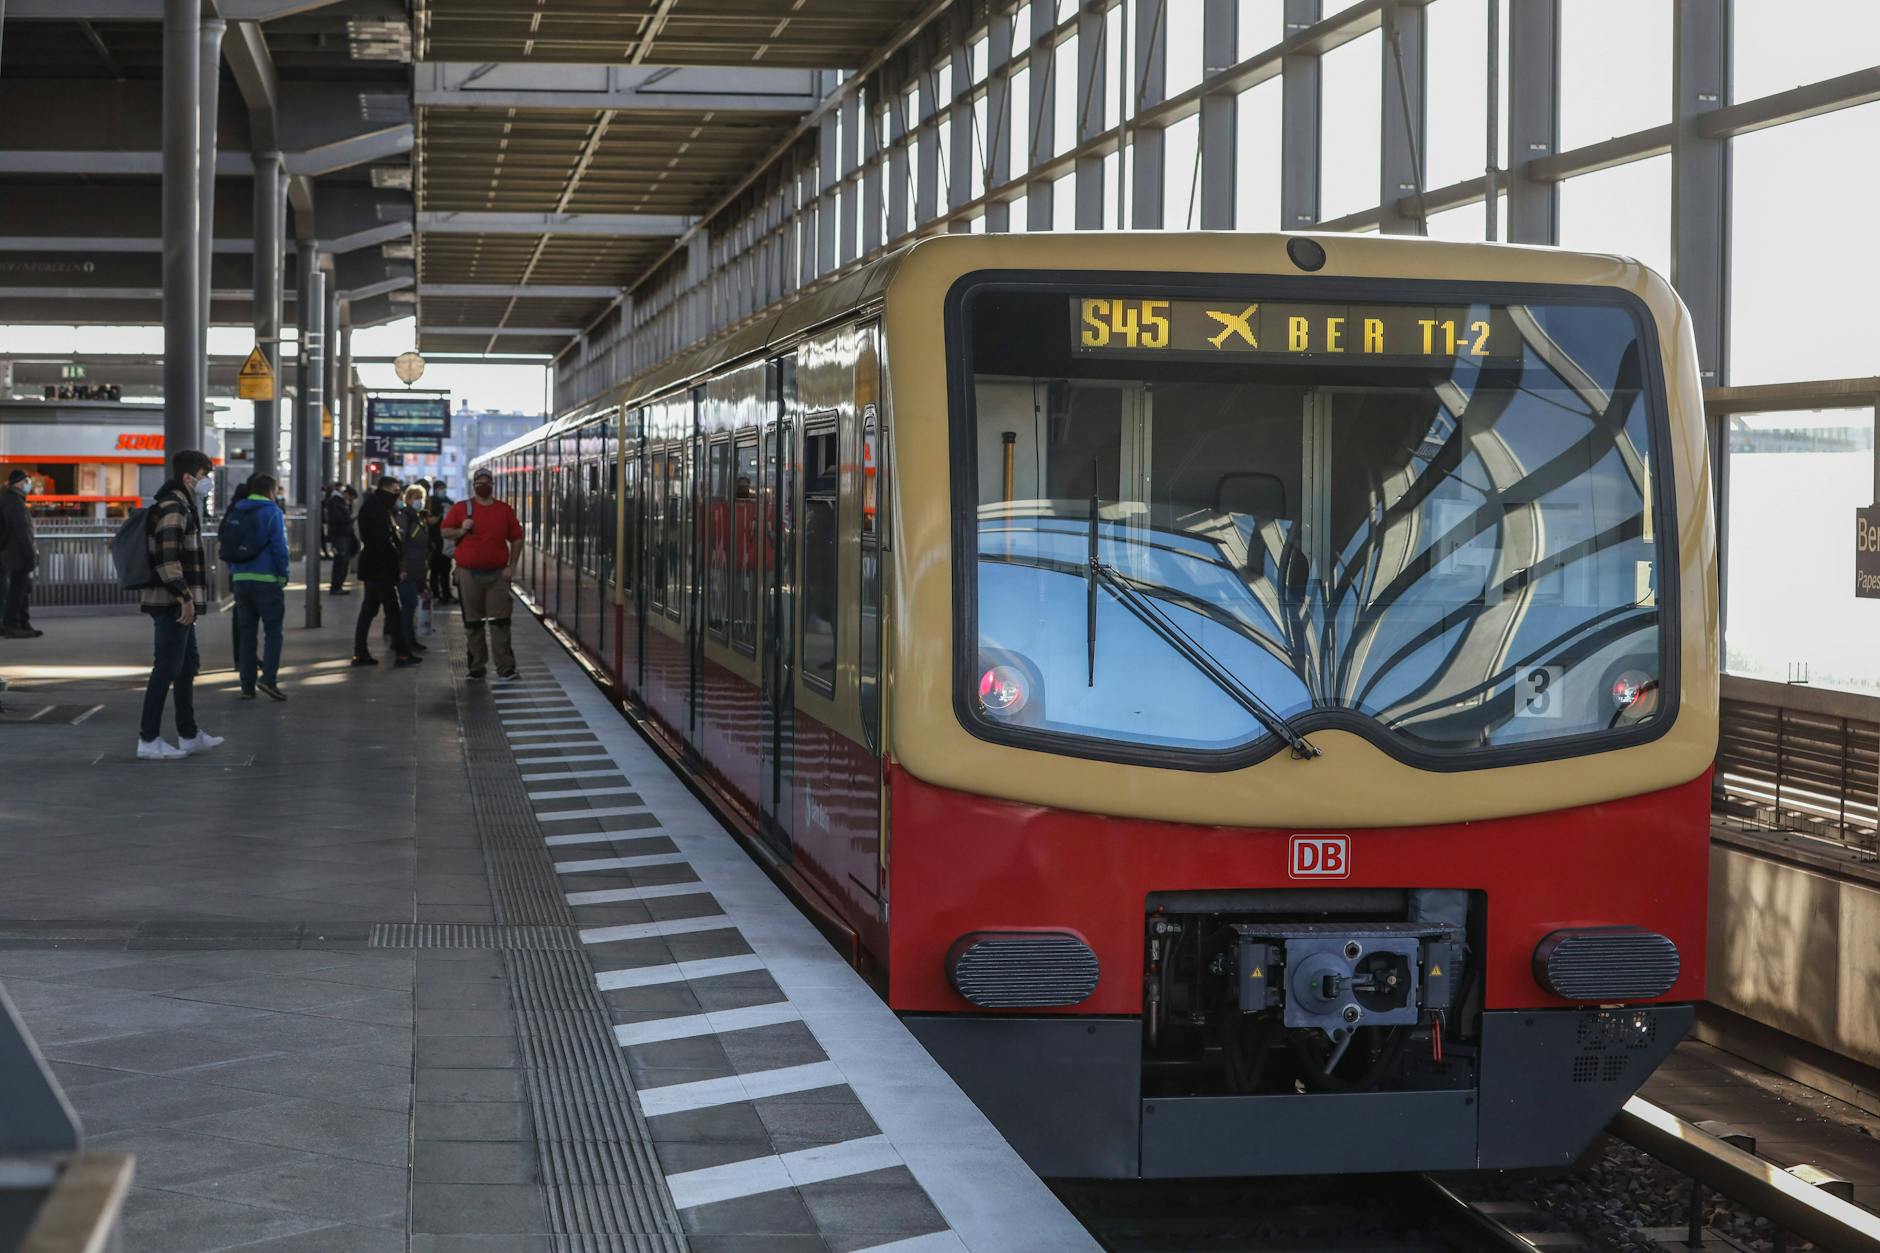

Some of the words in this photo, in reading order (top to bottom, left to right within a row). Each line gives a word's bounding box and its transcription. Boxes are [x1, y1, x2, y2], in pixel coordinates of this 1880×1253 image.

[1081, 299, 1169, 348] S45
[1418, 319, 1491, 356] T1-2
[374, 439, 390, 452] 12
[1527, 668, 1551, 715] 3
[1298, 843, 1342, 871] DB
